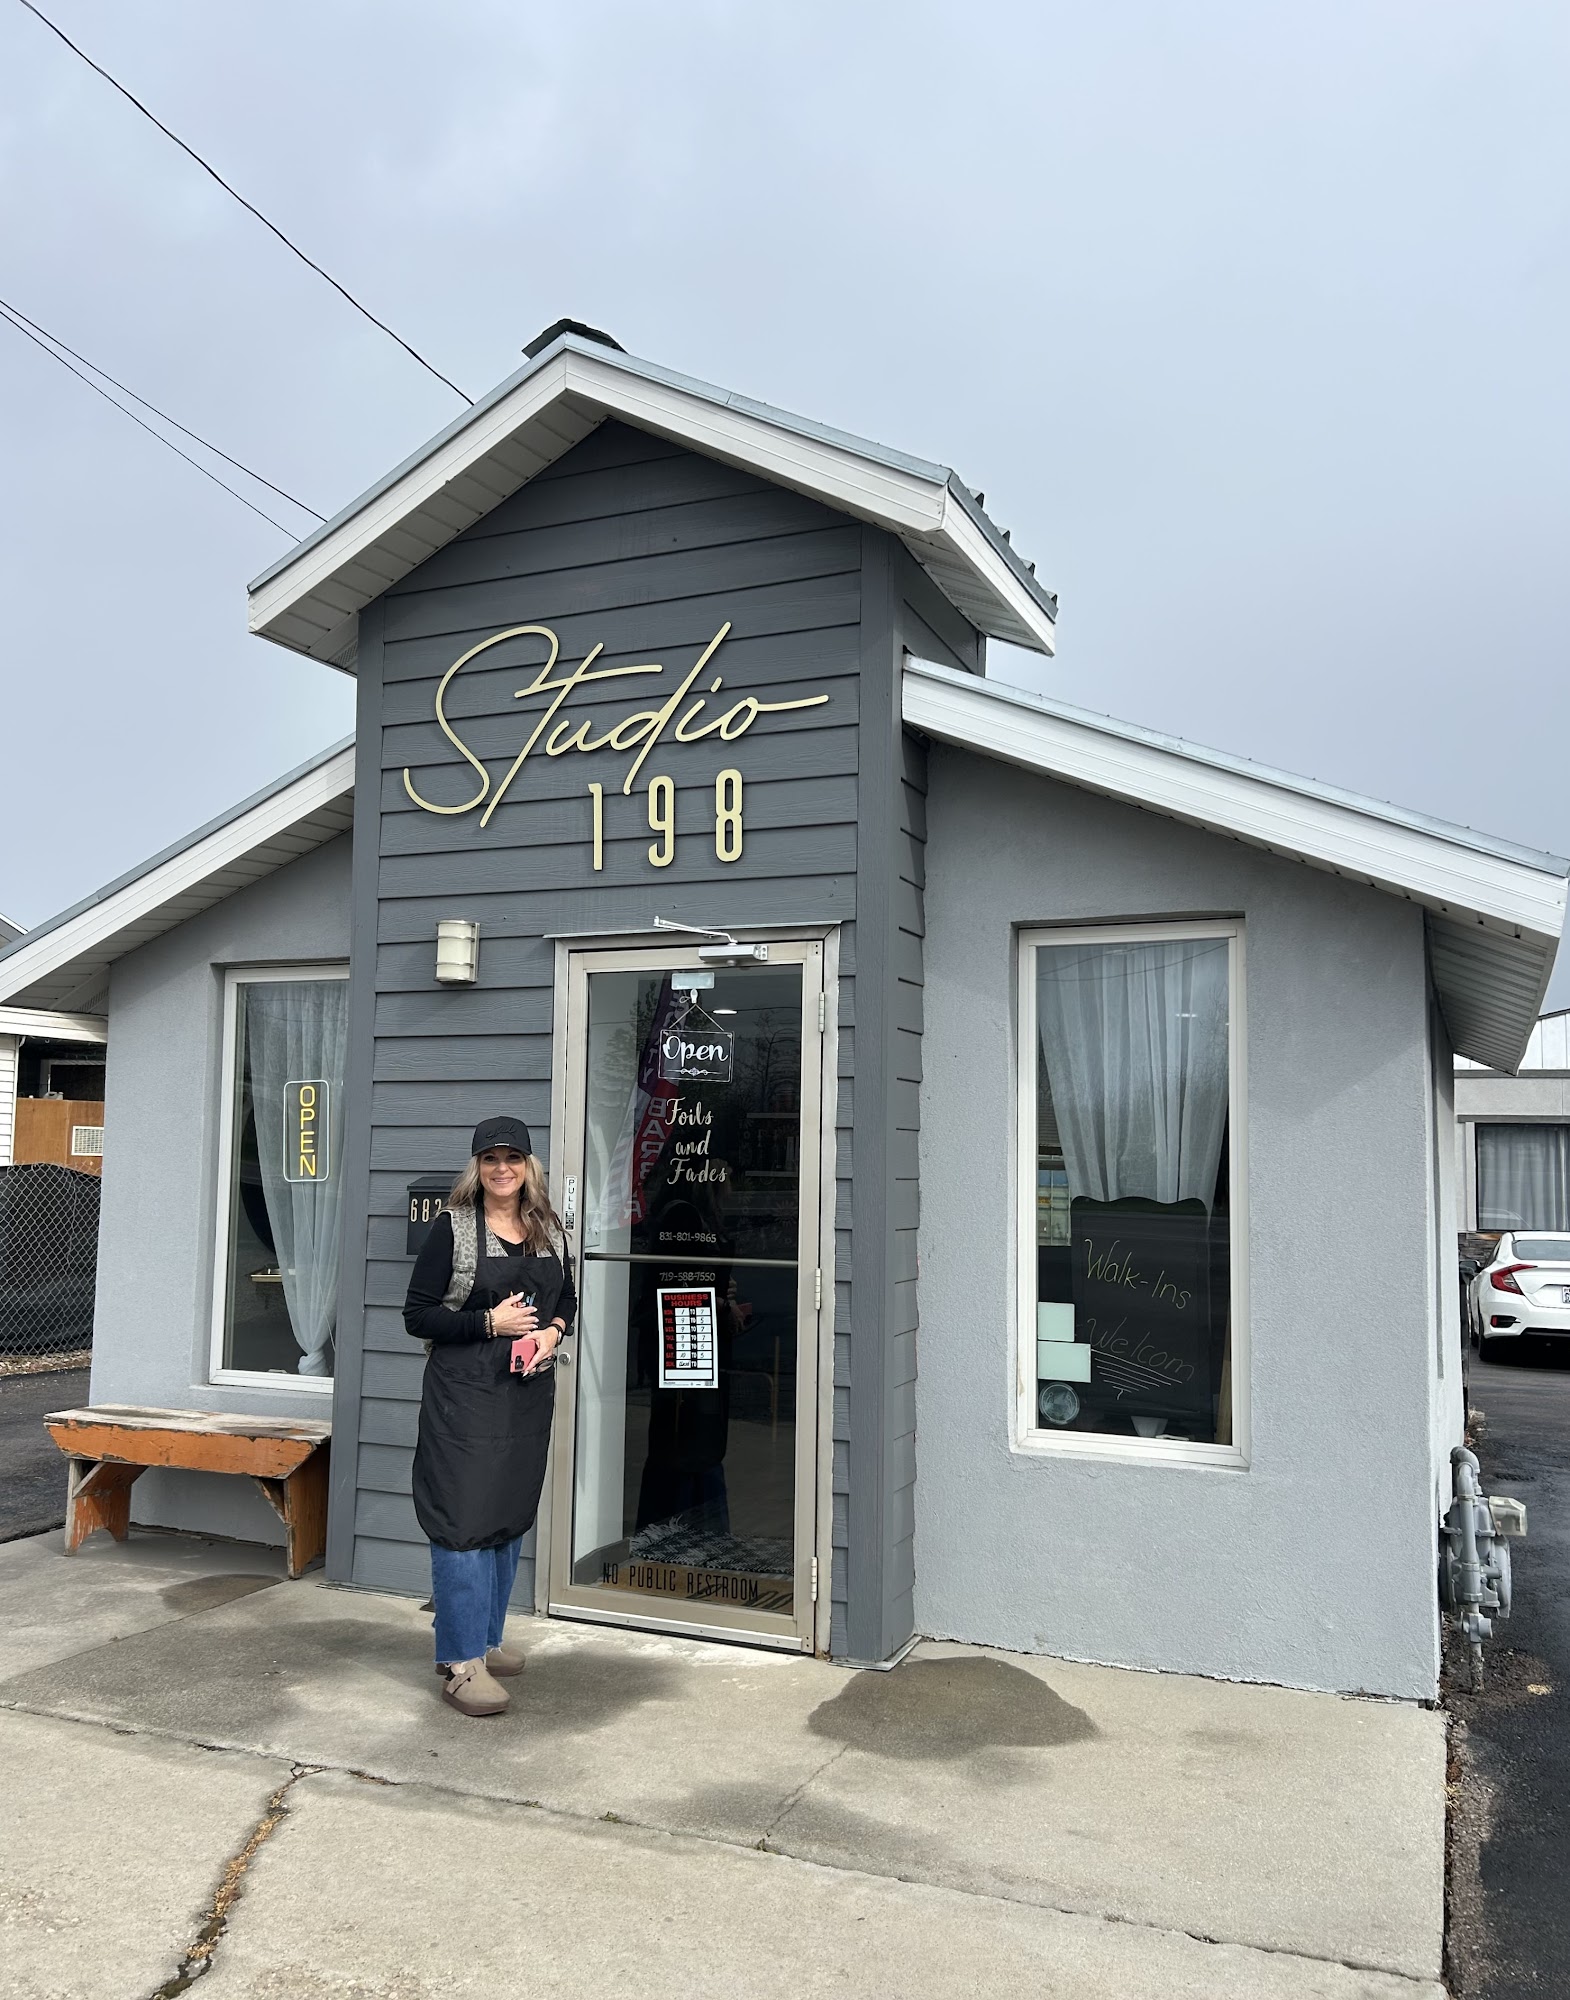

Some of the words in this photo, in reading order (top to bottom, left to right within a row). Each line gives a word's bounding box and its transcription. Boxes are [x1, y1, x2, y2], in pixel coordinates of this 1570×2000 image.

[403, 621, 830, 829] Studio
[588, 769, 744, 871] 198
[662, 1034, 729, 1068] Open
[664, 1097, 714, 1126] Foils
[299, 1085, 316, 1177] OPEN
[675, 1129, 710, 1156] and
[667, 1157, 728, 1185] Fades
[568, 1179, 576, 1210] PULL
[659, 1231, 717, 1243] 831-801-9865
[1084, 1238, 1191, 1309] Walk-Ins
[603, 1563, 619, 1584] NO
[629, 1565, 676, 1592] PUBLIC
[687, 1572, 758, 1600] RESTROOM
